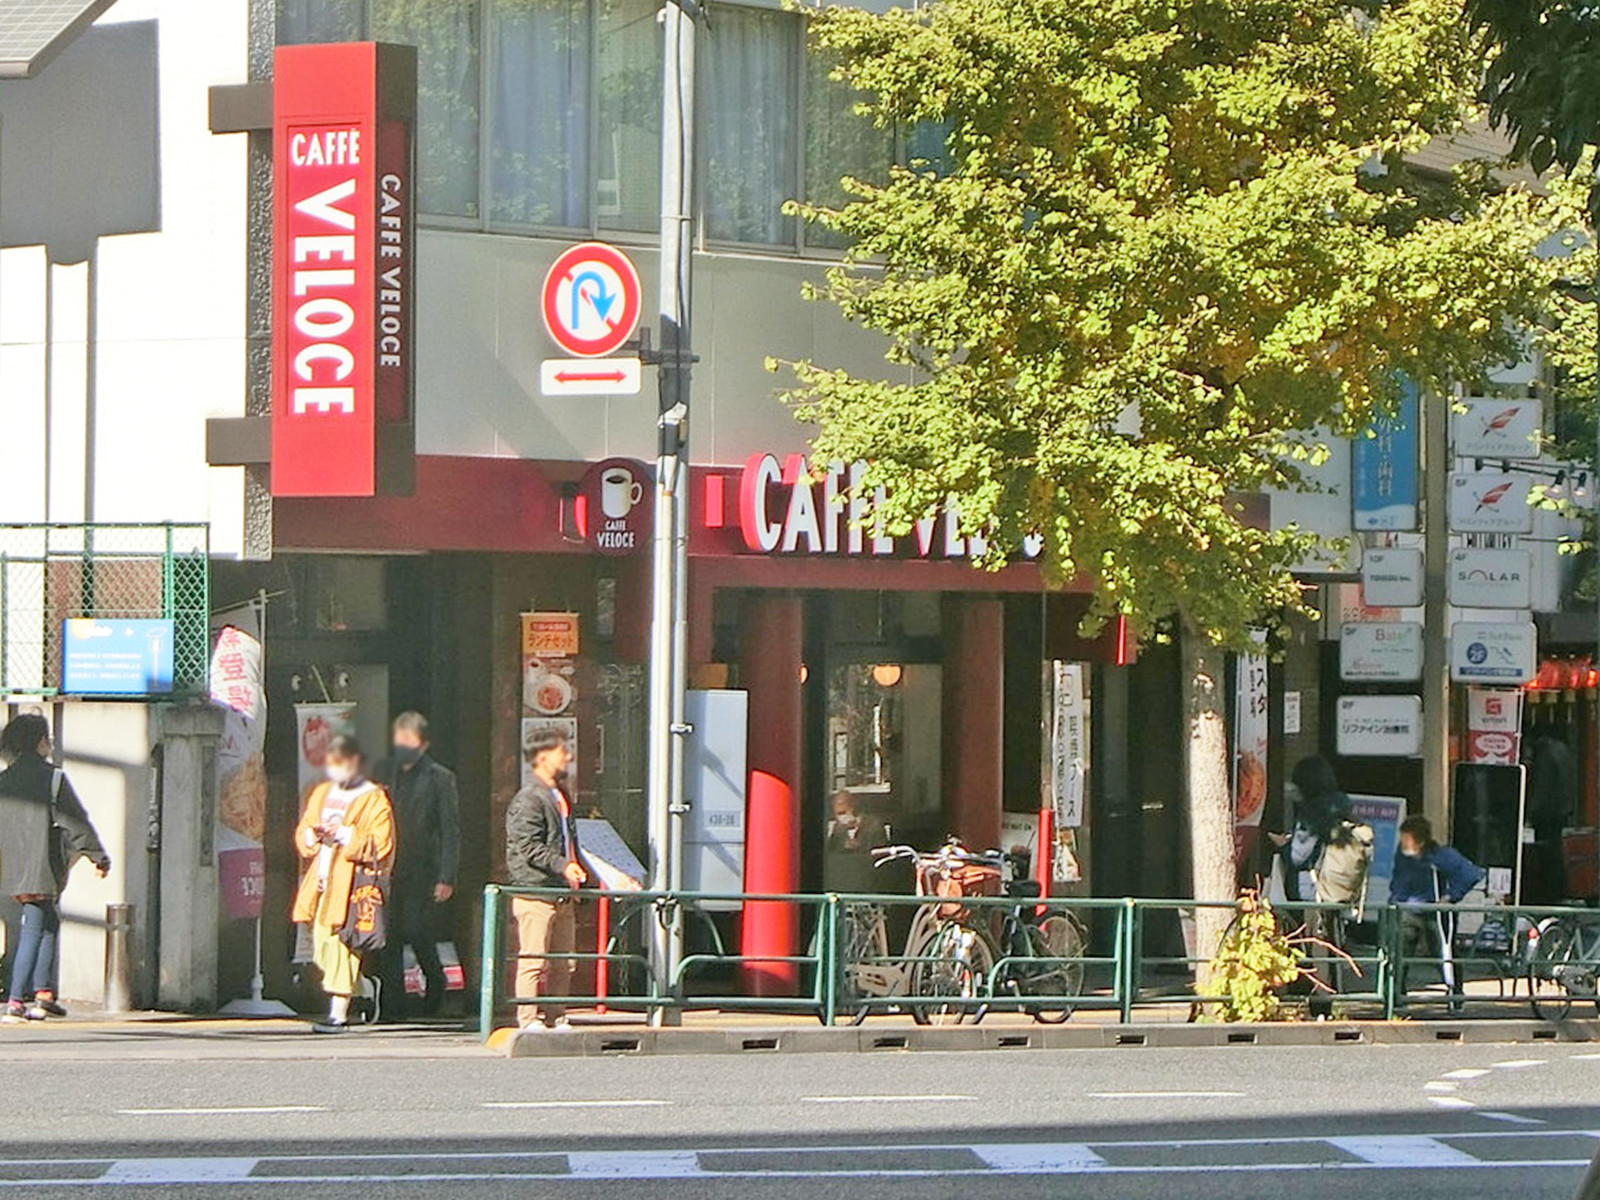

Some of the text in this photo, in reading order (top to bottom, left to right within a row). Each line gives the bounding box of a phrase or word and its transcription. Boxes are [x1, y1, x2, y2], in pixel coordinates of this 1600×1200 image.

[293, 177, 356, 414] VELOCE
[380, 266, 402, 368] VELOCE
[596, 532, 635, 548] VELOCE
